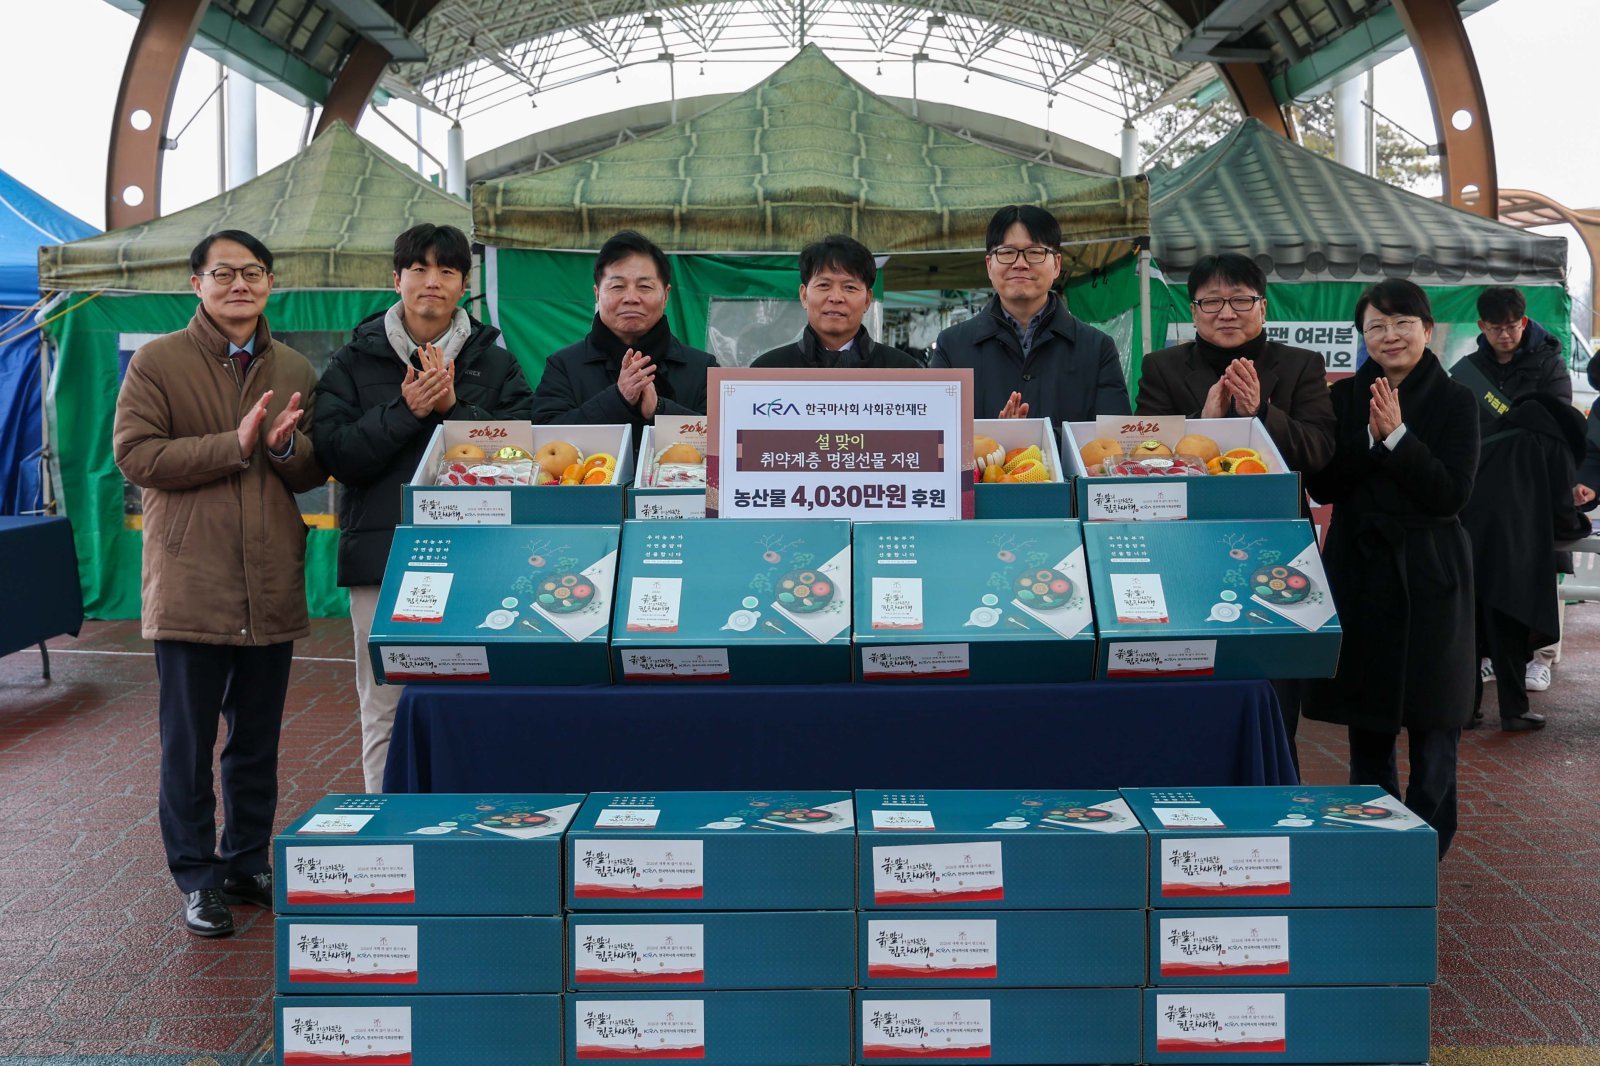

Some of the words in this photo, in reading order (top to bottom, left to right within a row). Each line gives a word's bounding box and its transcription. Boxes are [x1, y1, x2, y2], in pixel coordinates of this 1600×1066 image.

[1295, 328, 1353, 344] 여러분
[753, 399, 800, 417] KRA
[806, 403, 859, 415] 한국마사회
[863, 403, 927, 415] 사회공헌재단
[816, 434, 830, 450] 설
[836, 434, 864, 450] 맞이
[760, 452, 821, 469] 취약계층
[827, 452, 886, 469] 명절선물
[891, 452, 920, 469] 지원
[734, 489, 786, 508] 농산물
[791, 484, 906, 511] 4,030만원
[911, 489, 945, 508] 후원
